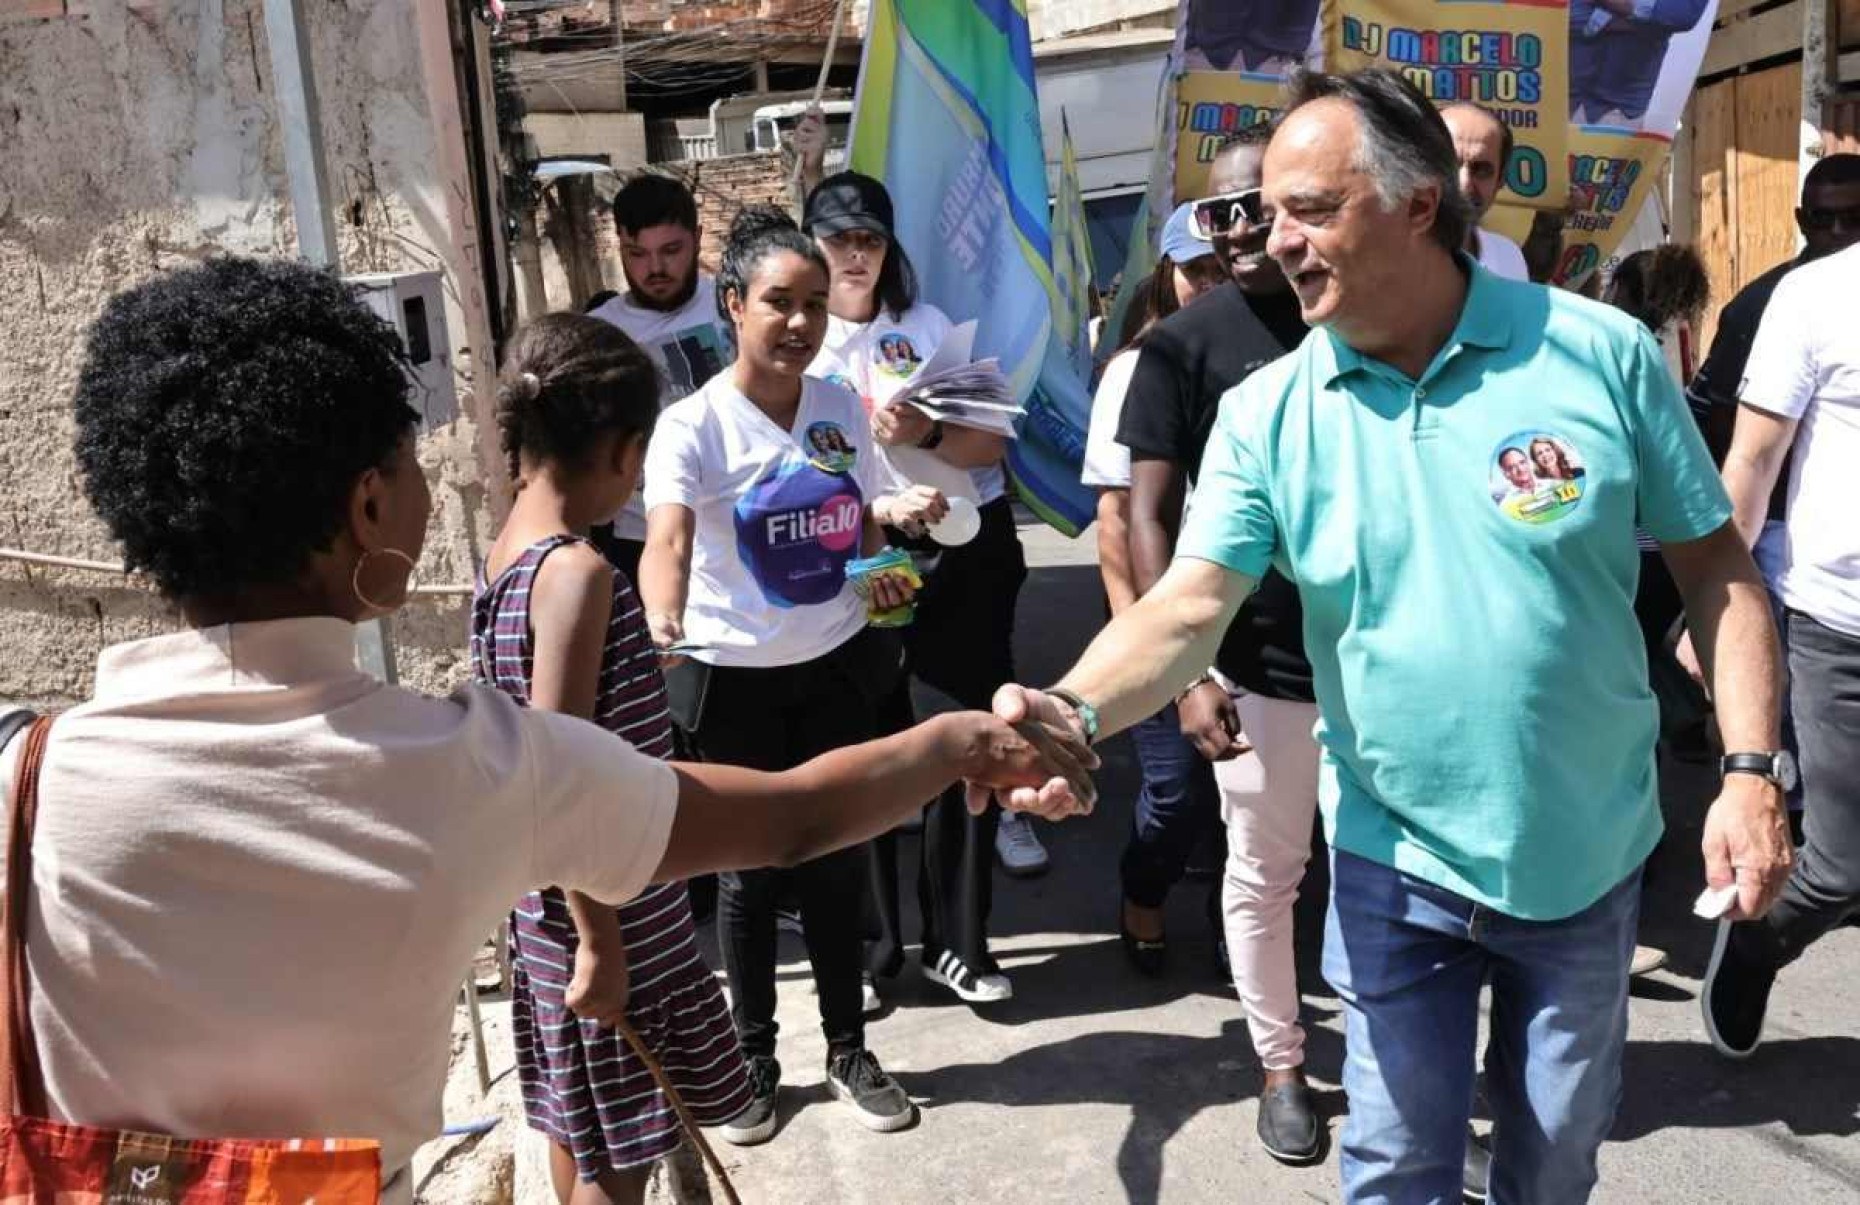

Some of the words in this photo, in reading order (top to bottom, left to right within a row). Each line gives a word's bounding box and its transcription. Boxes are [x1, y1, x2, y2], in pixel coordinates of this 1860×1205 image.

[1342, 16, 1382, 57] DJ
[1386, 27, 1542, 69] MARCELO
[1401, 65, 1542, 103] MATTOS
